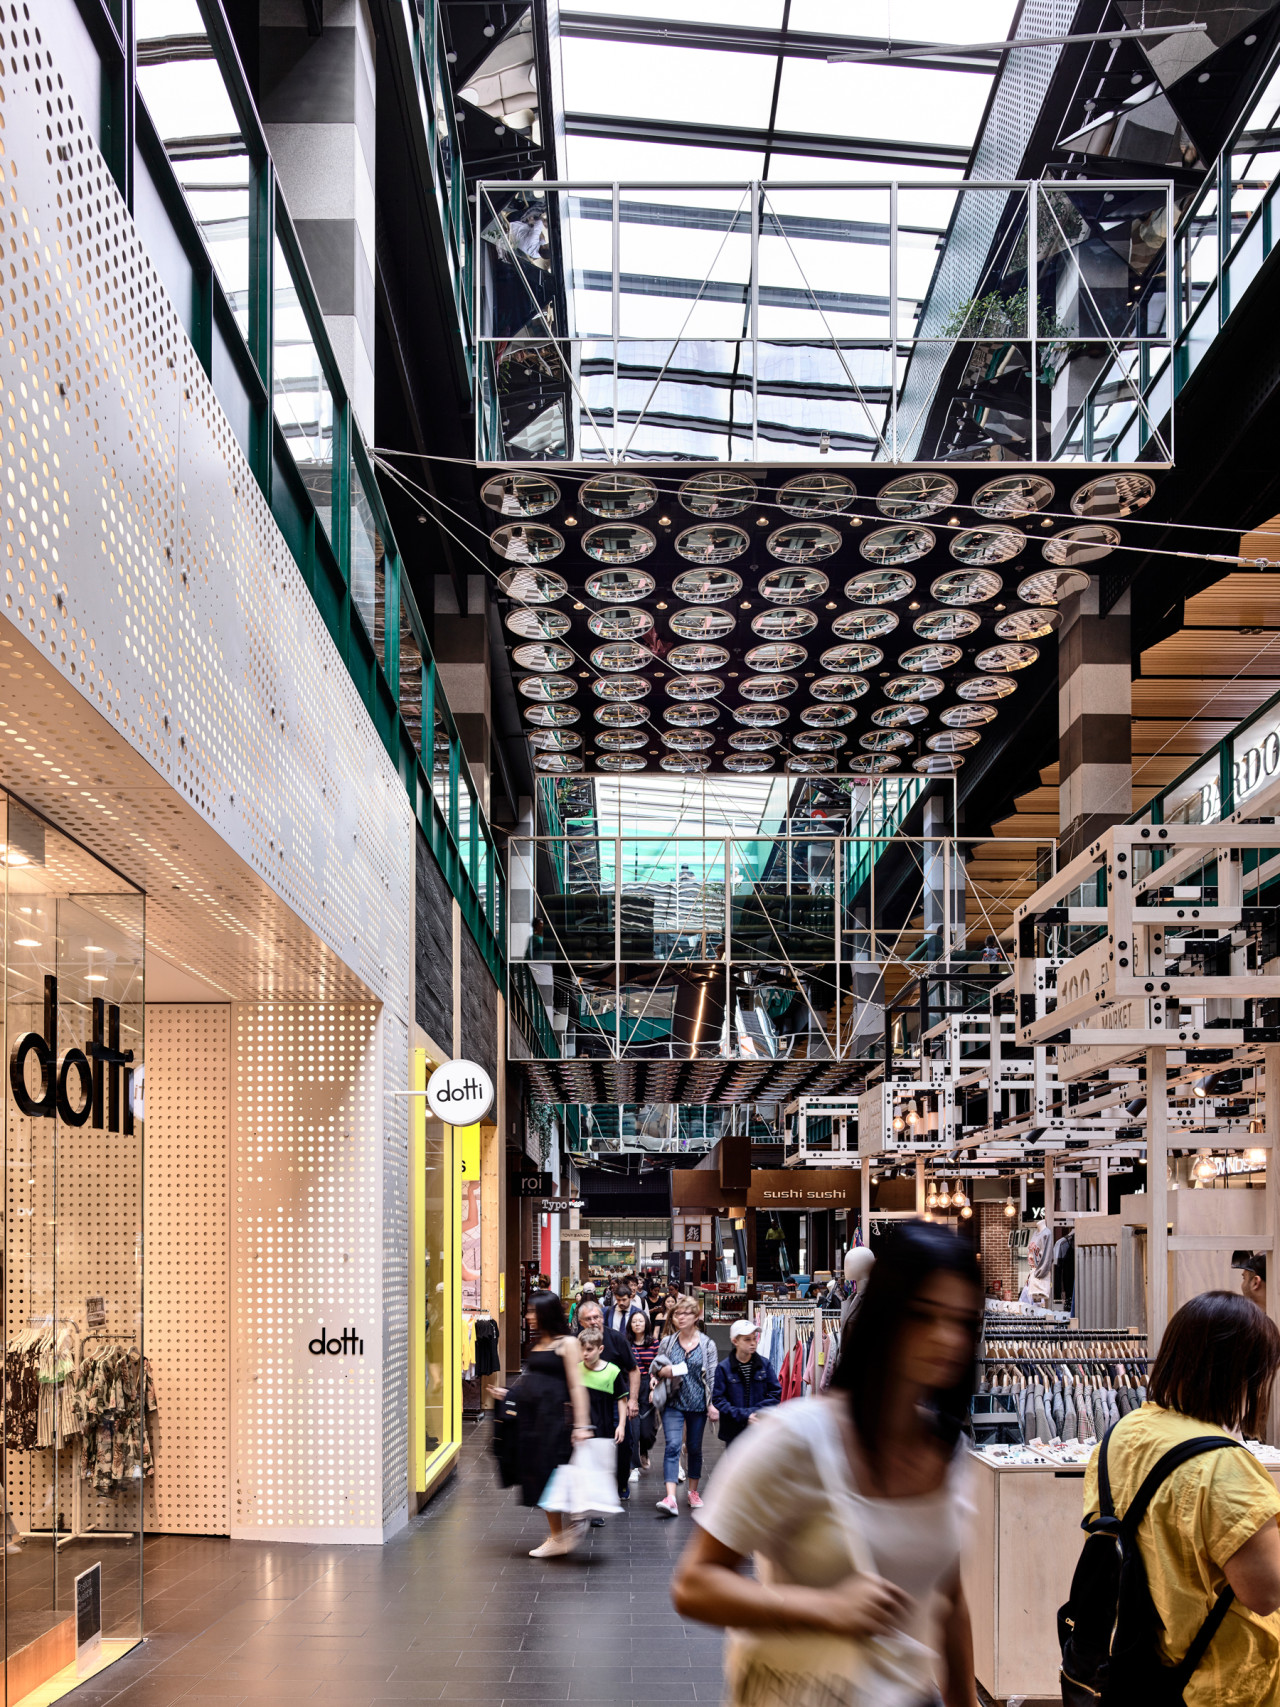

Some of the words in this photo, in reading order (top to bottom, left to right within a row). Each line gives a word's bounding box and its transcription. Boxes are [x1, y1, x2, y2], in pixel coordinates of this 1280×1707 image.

[1101, 1002, 1132, 1030] MARKET
[10, 975, 134, 1136] dotti
[436, 1077, 483, 1102] dotti
[1213, 1157, 1265, 1176] WNDS
[521, 1175, 542, 1190] roi
[541, 1199, 567, 1211] Typo
[763, 1189, 803, 1198] sushi
[806, 1189, 846, 1199] sushi
[308, 1327, 364, 1356] dotti
